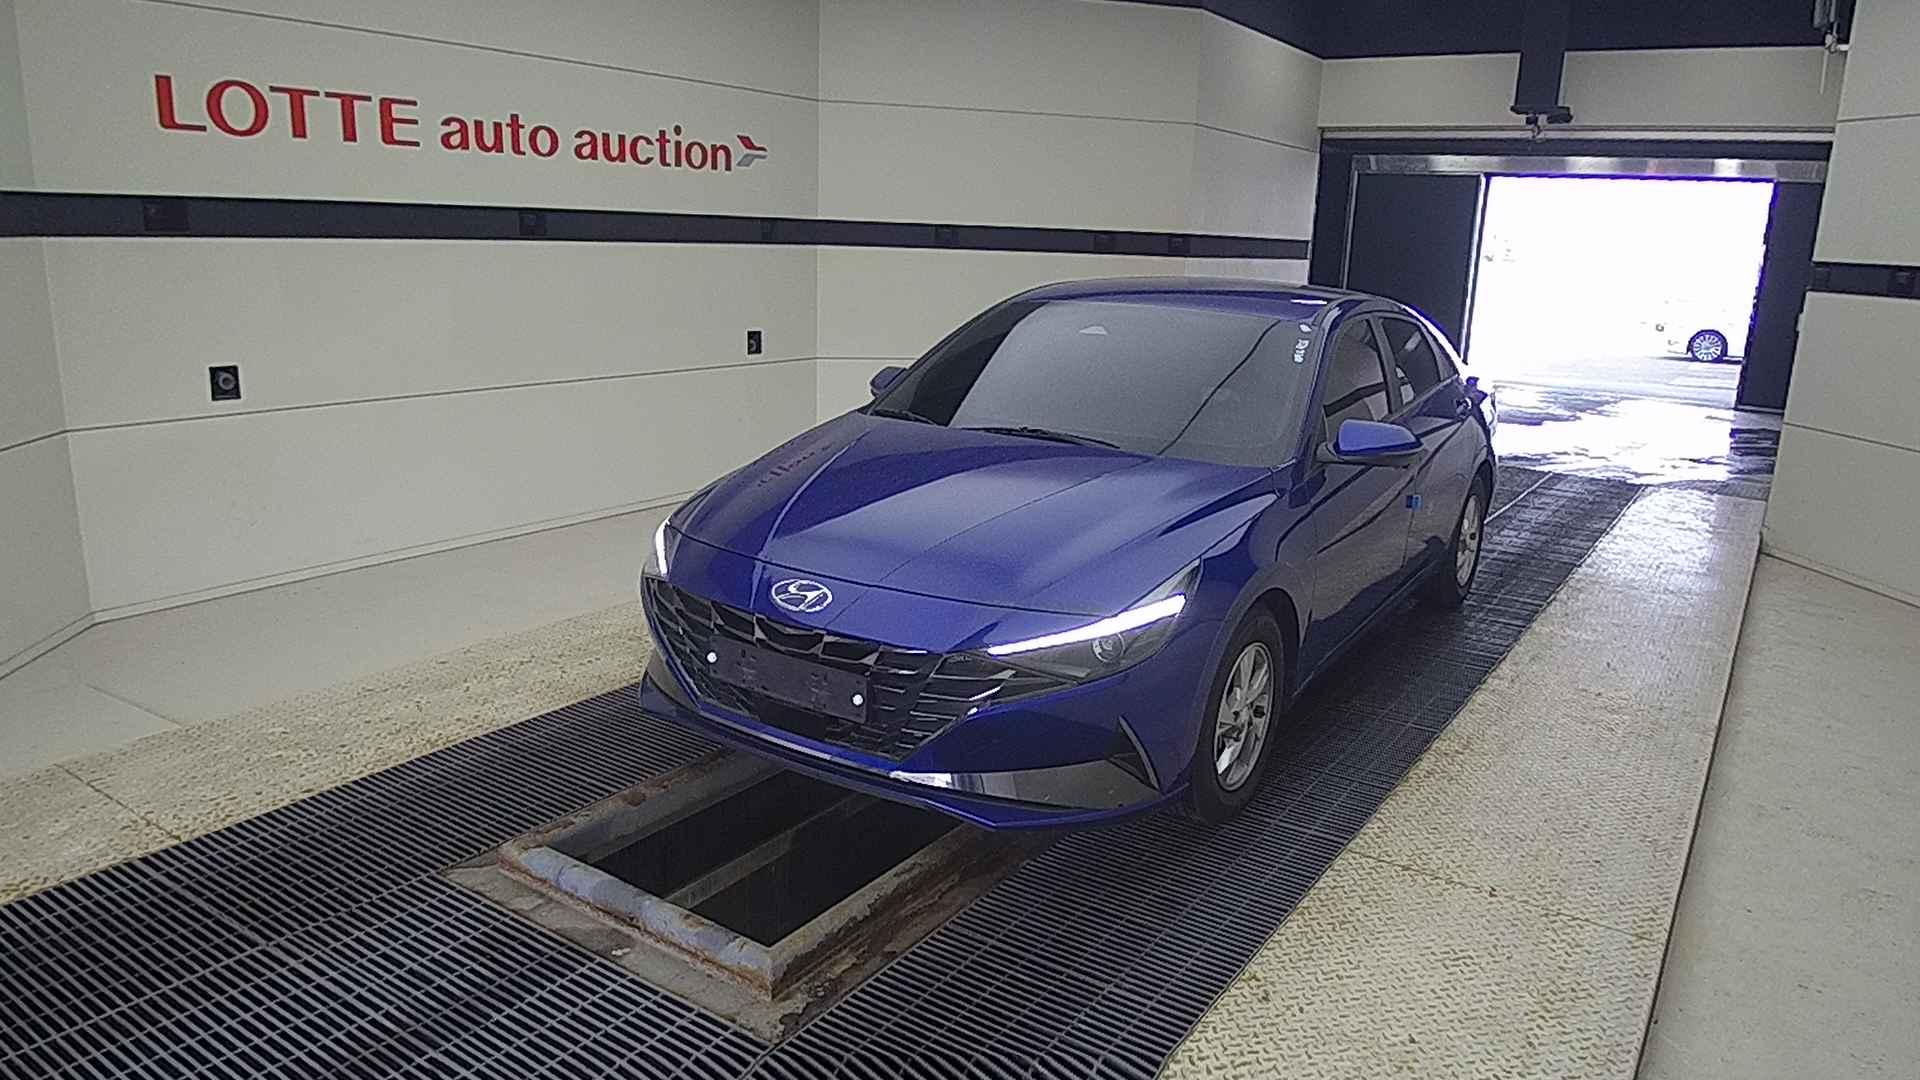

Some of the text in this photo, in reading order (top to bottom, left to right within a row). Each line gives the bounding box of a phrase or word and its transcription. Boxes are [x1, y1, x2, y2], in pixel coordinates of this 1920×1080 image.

[154, 74, 732, 171] LOTTE auto auction
